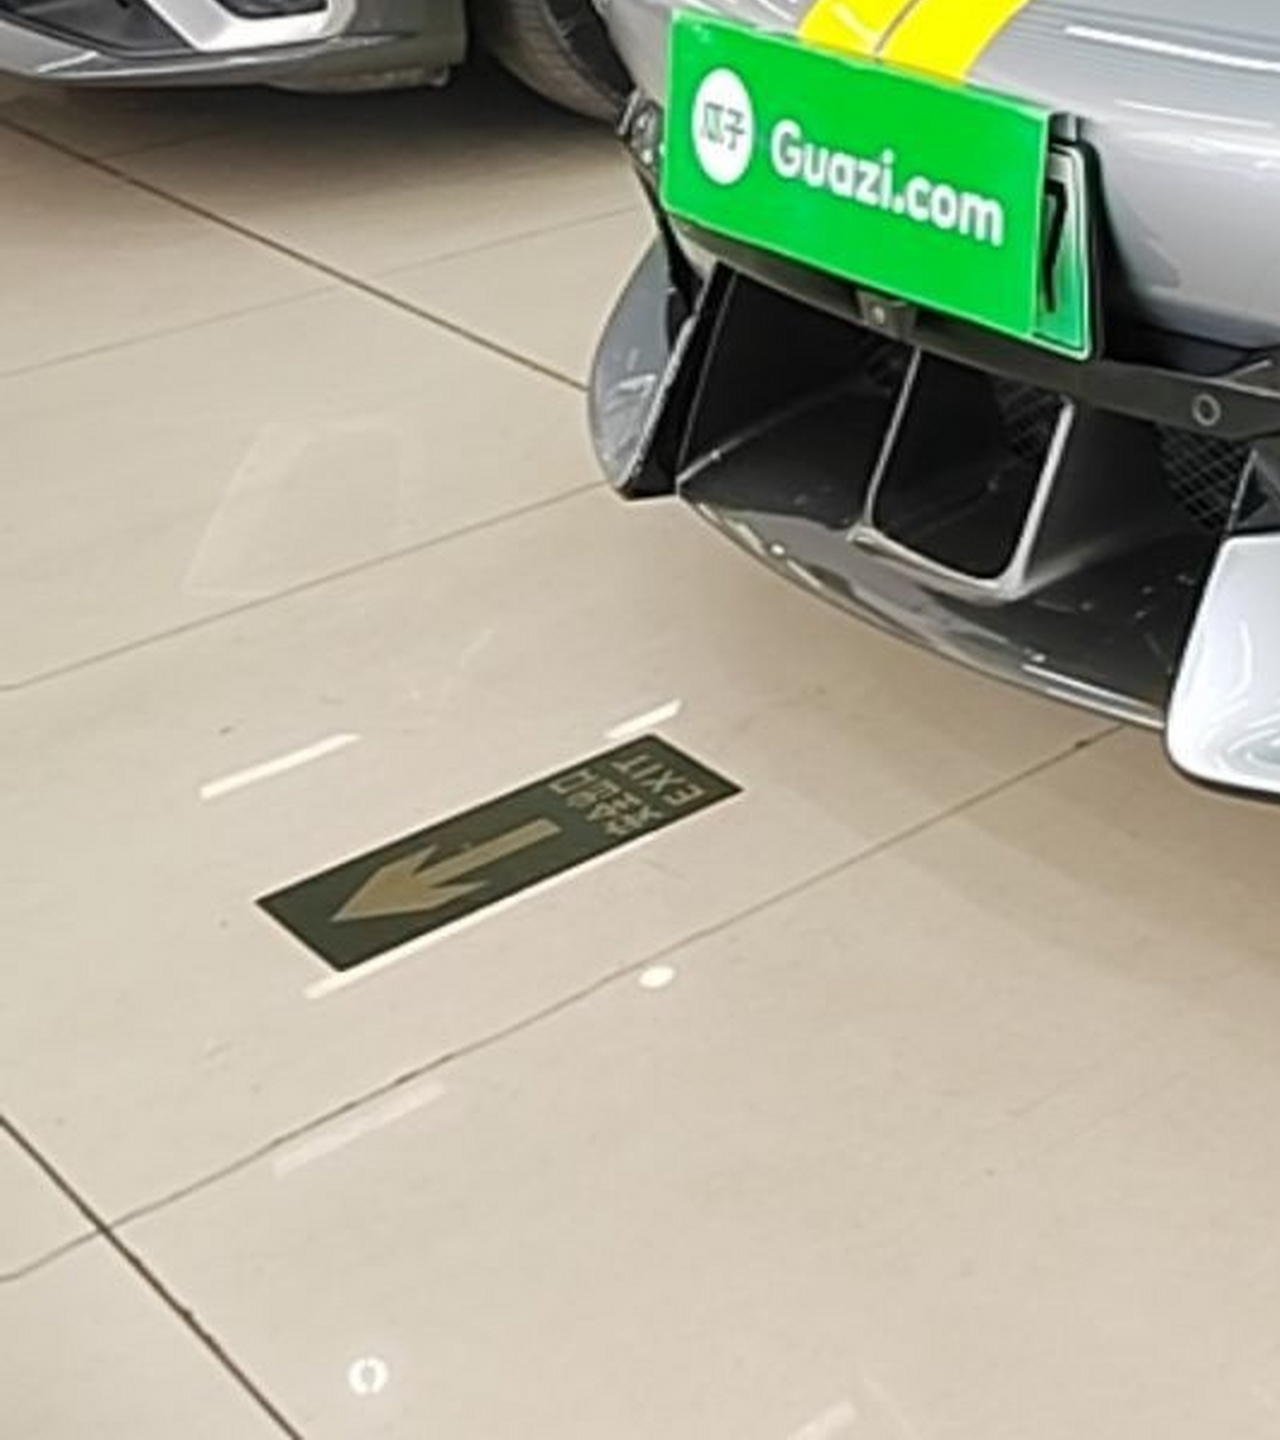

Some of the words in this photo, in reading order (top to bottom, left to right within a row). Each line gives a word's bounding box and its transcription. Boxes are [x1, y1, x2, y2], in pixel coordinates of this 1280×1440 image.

[770, 118, 1004, 248] Guazi.com
[549, 769, 664, 835] 安全出口
[610, 755, 705, 806] EXIT
